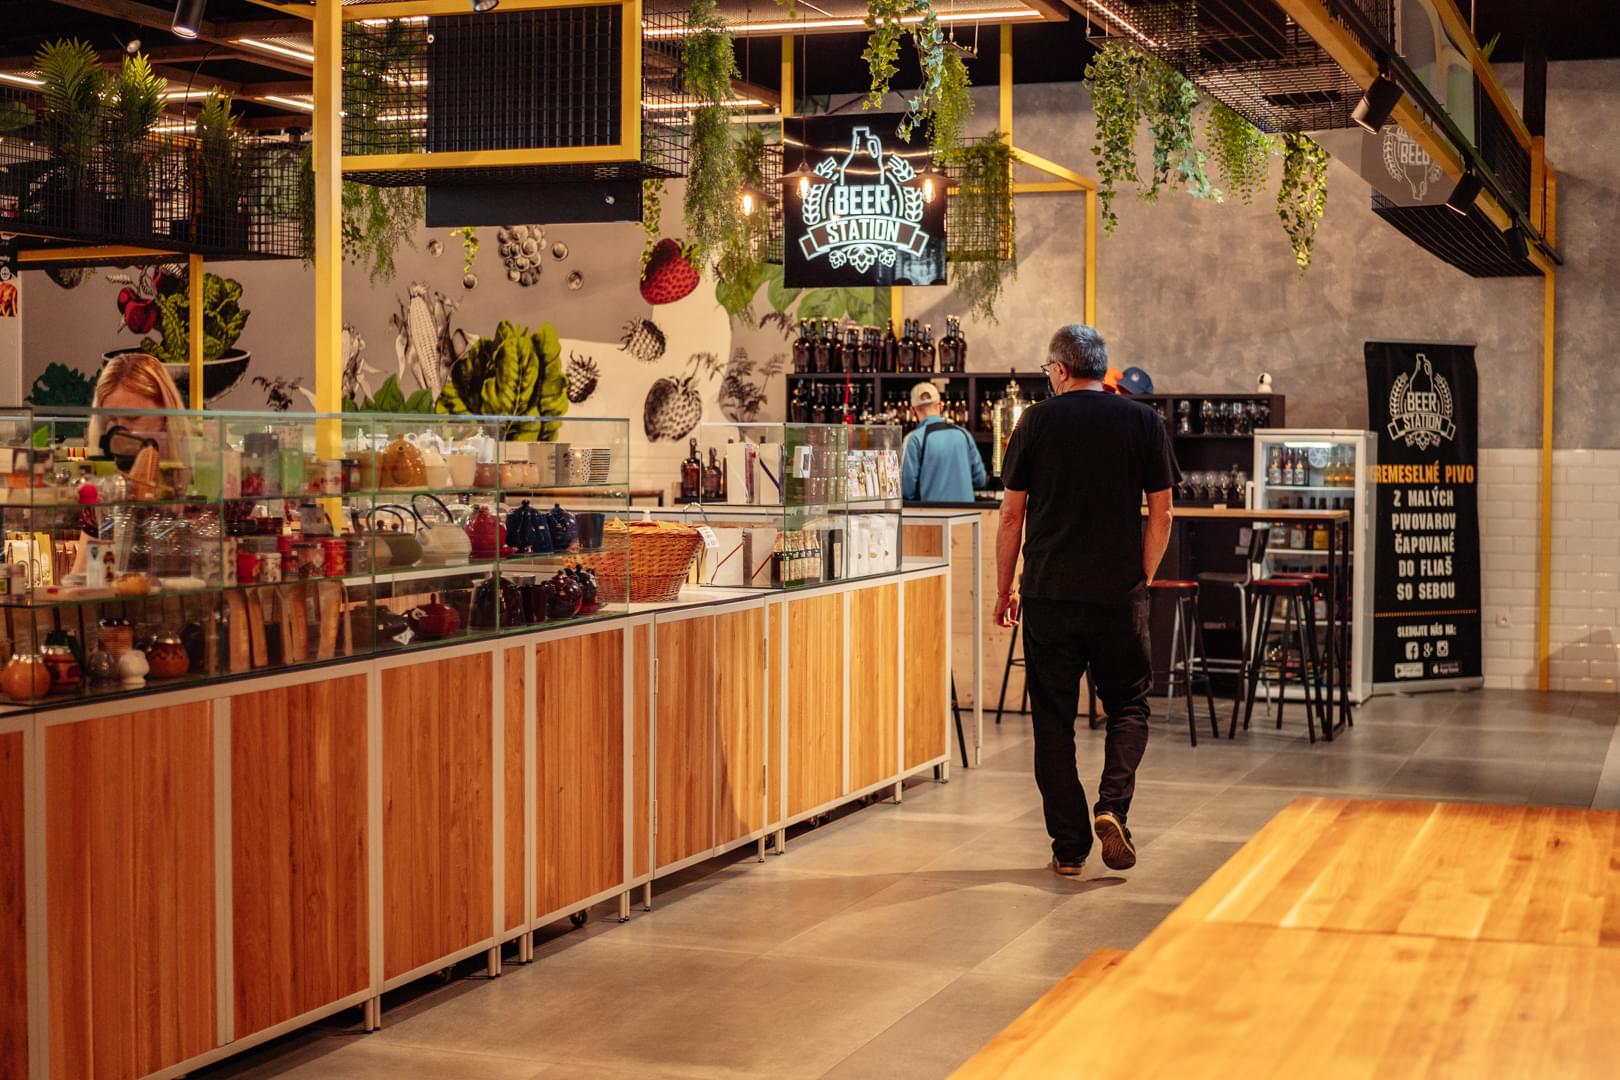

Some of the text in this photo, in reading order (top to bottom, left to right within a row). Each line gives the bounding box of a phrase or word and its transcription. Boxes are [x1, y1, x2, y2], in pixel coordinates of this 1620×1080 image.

[834, 184, 891, 215] BEER
[826, 219, 900, 243] STATION
[1407, 392, 1437, 412] BEER
[1402, 413, 1442, 430] STATION
[1373, 459, 1474, 484] REMESELNÉ PIVO
[1408, 485, 1454, 507] MALÝCH
[1391, 512, 1456, 531] PIVOVAROV
[1395, 531, 1455, 554] ČAPOVANÉ
[1398, 555, 1453, 577] DO FLIAŠ
[1397, 581, 1455, 600] SO SEBOU
